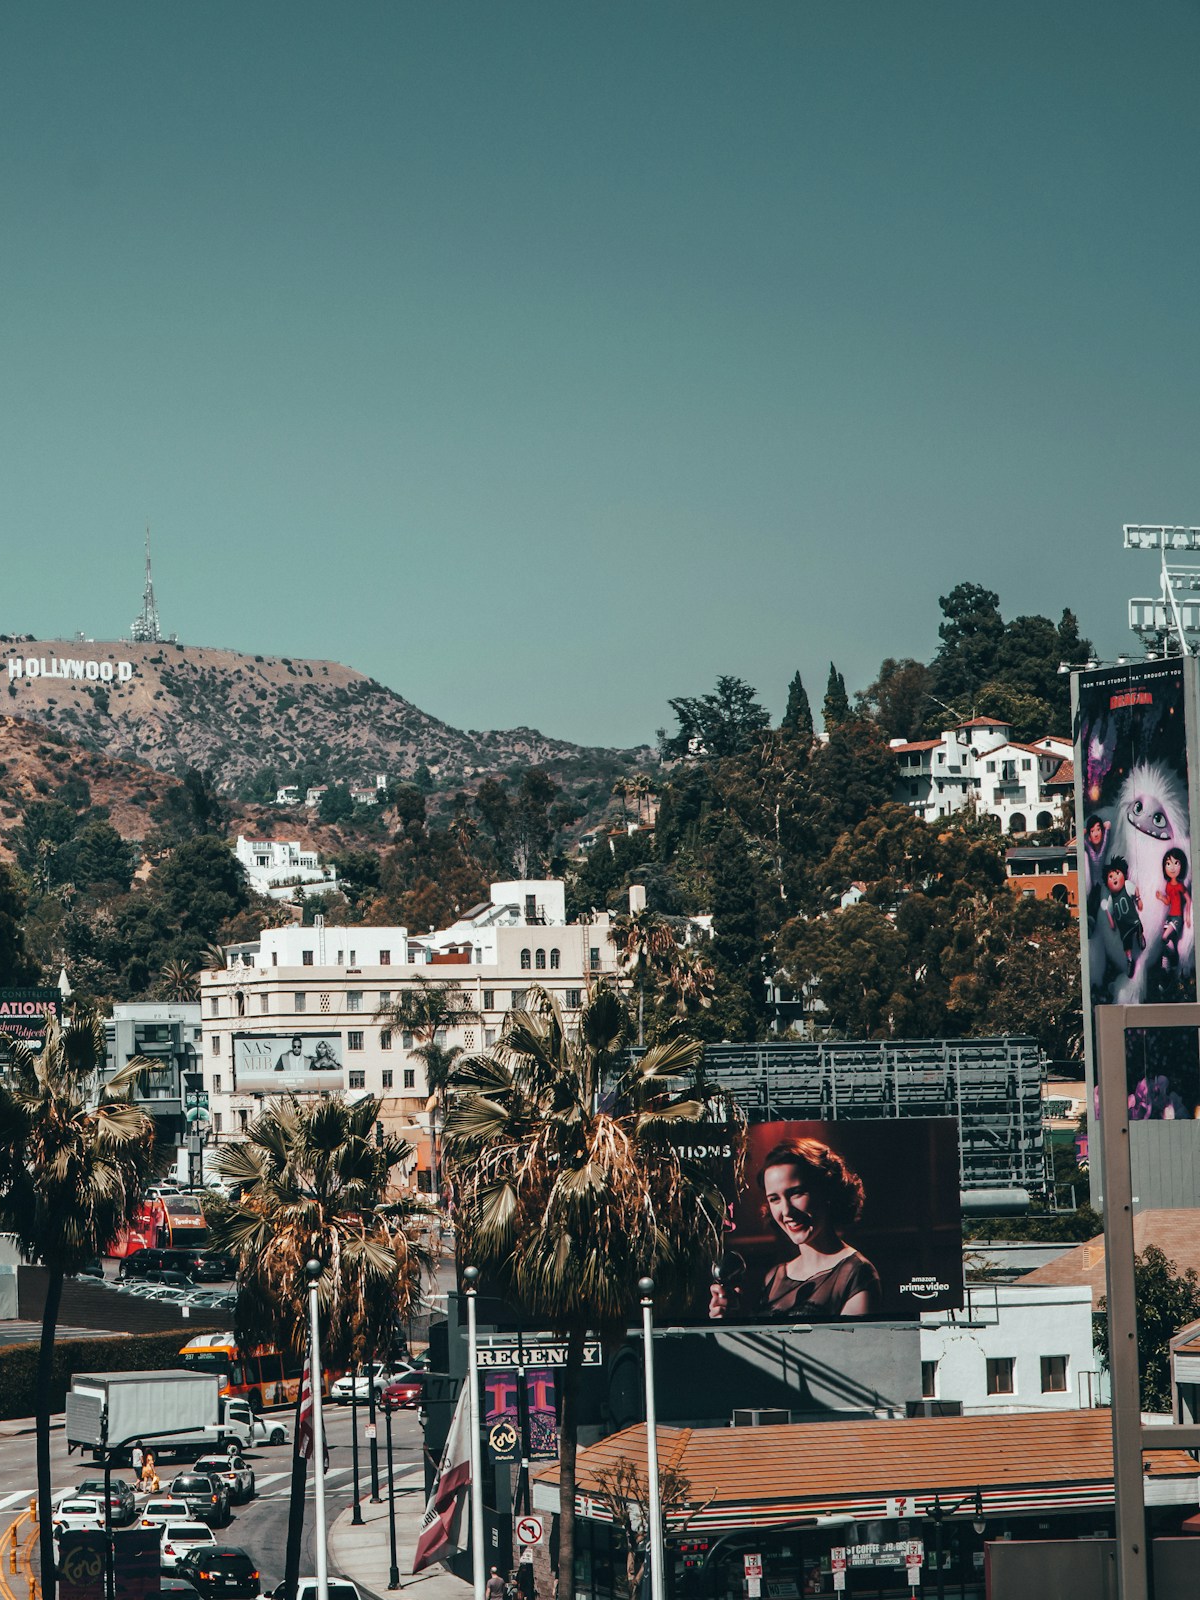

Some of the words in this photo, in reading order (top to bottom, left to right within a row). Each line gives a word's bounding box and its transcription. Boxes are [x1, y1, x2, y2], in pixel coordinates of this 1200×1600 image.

[8, 658, 132, 682] HOLLYWOOD
[1107, 677, 1127, 685] STUDIO
[242, 1041, 272, 1055] NAS
[243, 1057, 273, 1070] MJB
[900, 1282, 925, 1294] prime
[926, 1282, 950, 1291] video
[476, 1347, 597, 1366] REGENY
[855, 1543, 880, 1555] COFFEE
